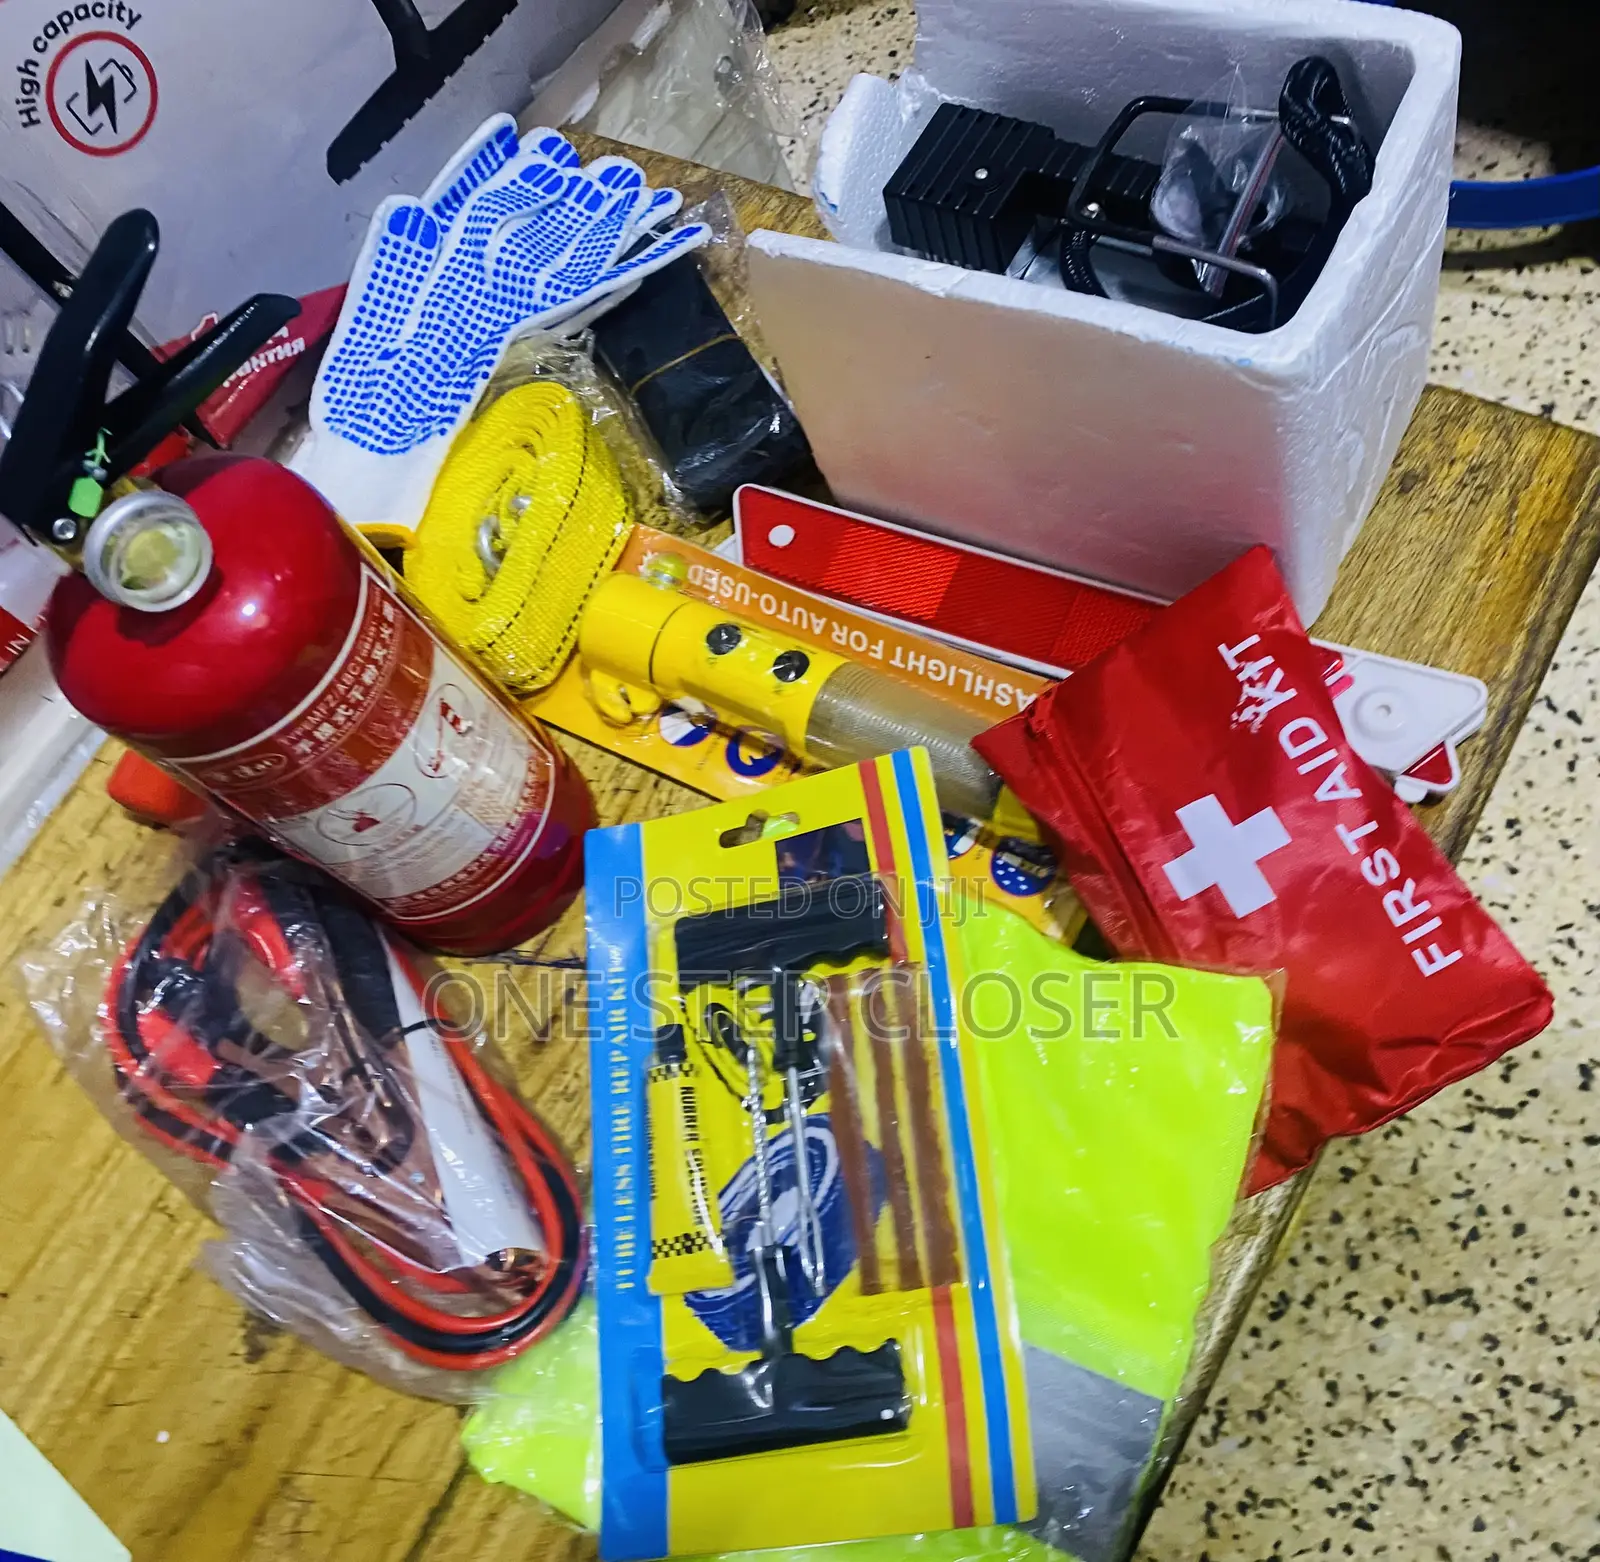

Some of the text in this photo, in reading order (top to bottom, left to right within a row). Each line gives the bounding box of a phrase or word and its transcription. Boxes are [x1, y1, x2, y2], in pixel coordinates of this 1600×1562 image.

[15, 0, 142, 129] High capacity
[686, 563, 827, 637] AUTO-USED
[831, 622, 884, 660] FOR
[1278, 716, 1363, 802] AID
[1335, 820, 1463, 978] FIRST
[607, 966, 628, 1002] KIT
[607, 1008, 630, 1094] REPAIR
[610, 1103, 634, 1155] TIRE
[680, 1086, 702, 1143] RUBBER
